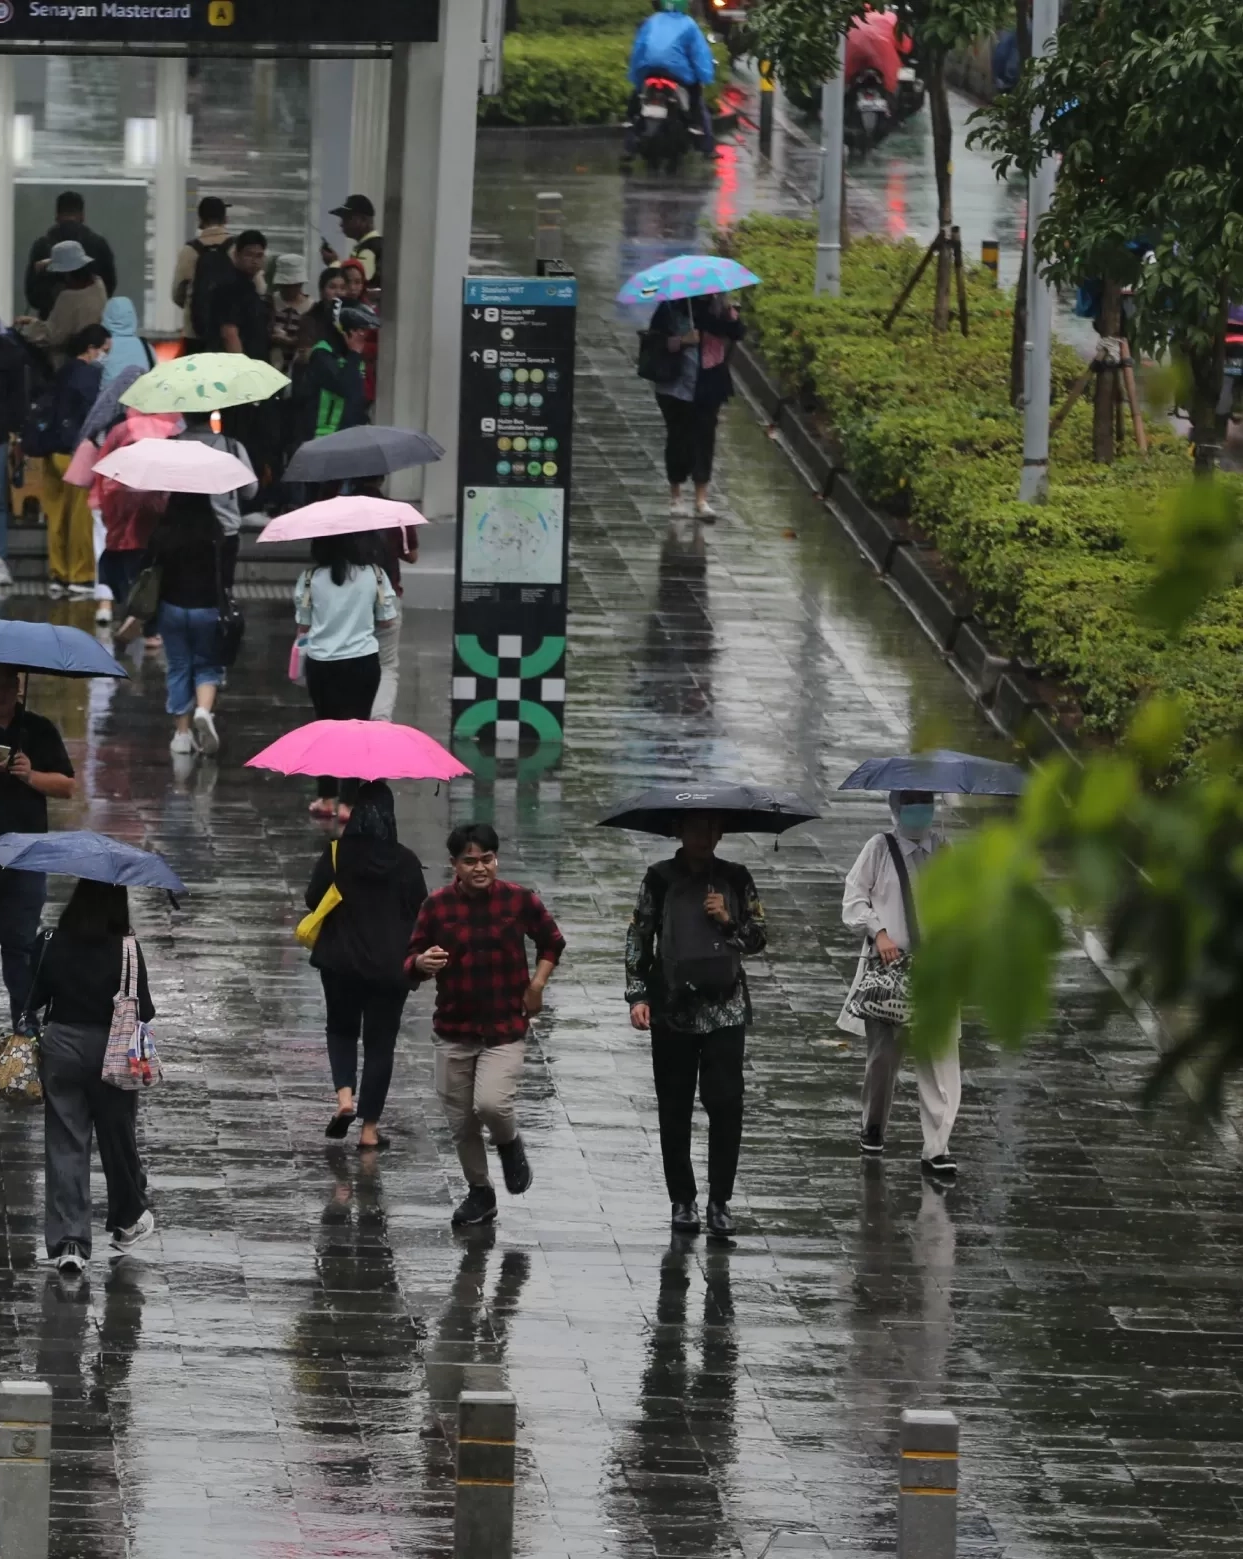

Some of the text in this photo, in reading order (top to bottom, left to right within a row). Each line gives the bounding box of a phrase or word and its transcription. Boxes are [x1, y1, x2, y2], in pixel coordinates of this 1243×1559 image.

[29, 1, 226, 20] Senayan Mastercard A
